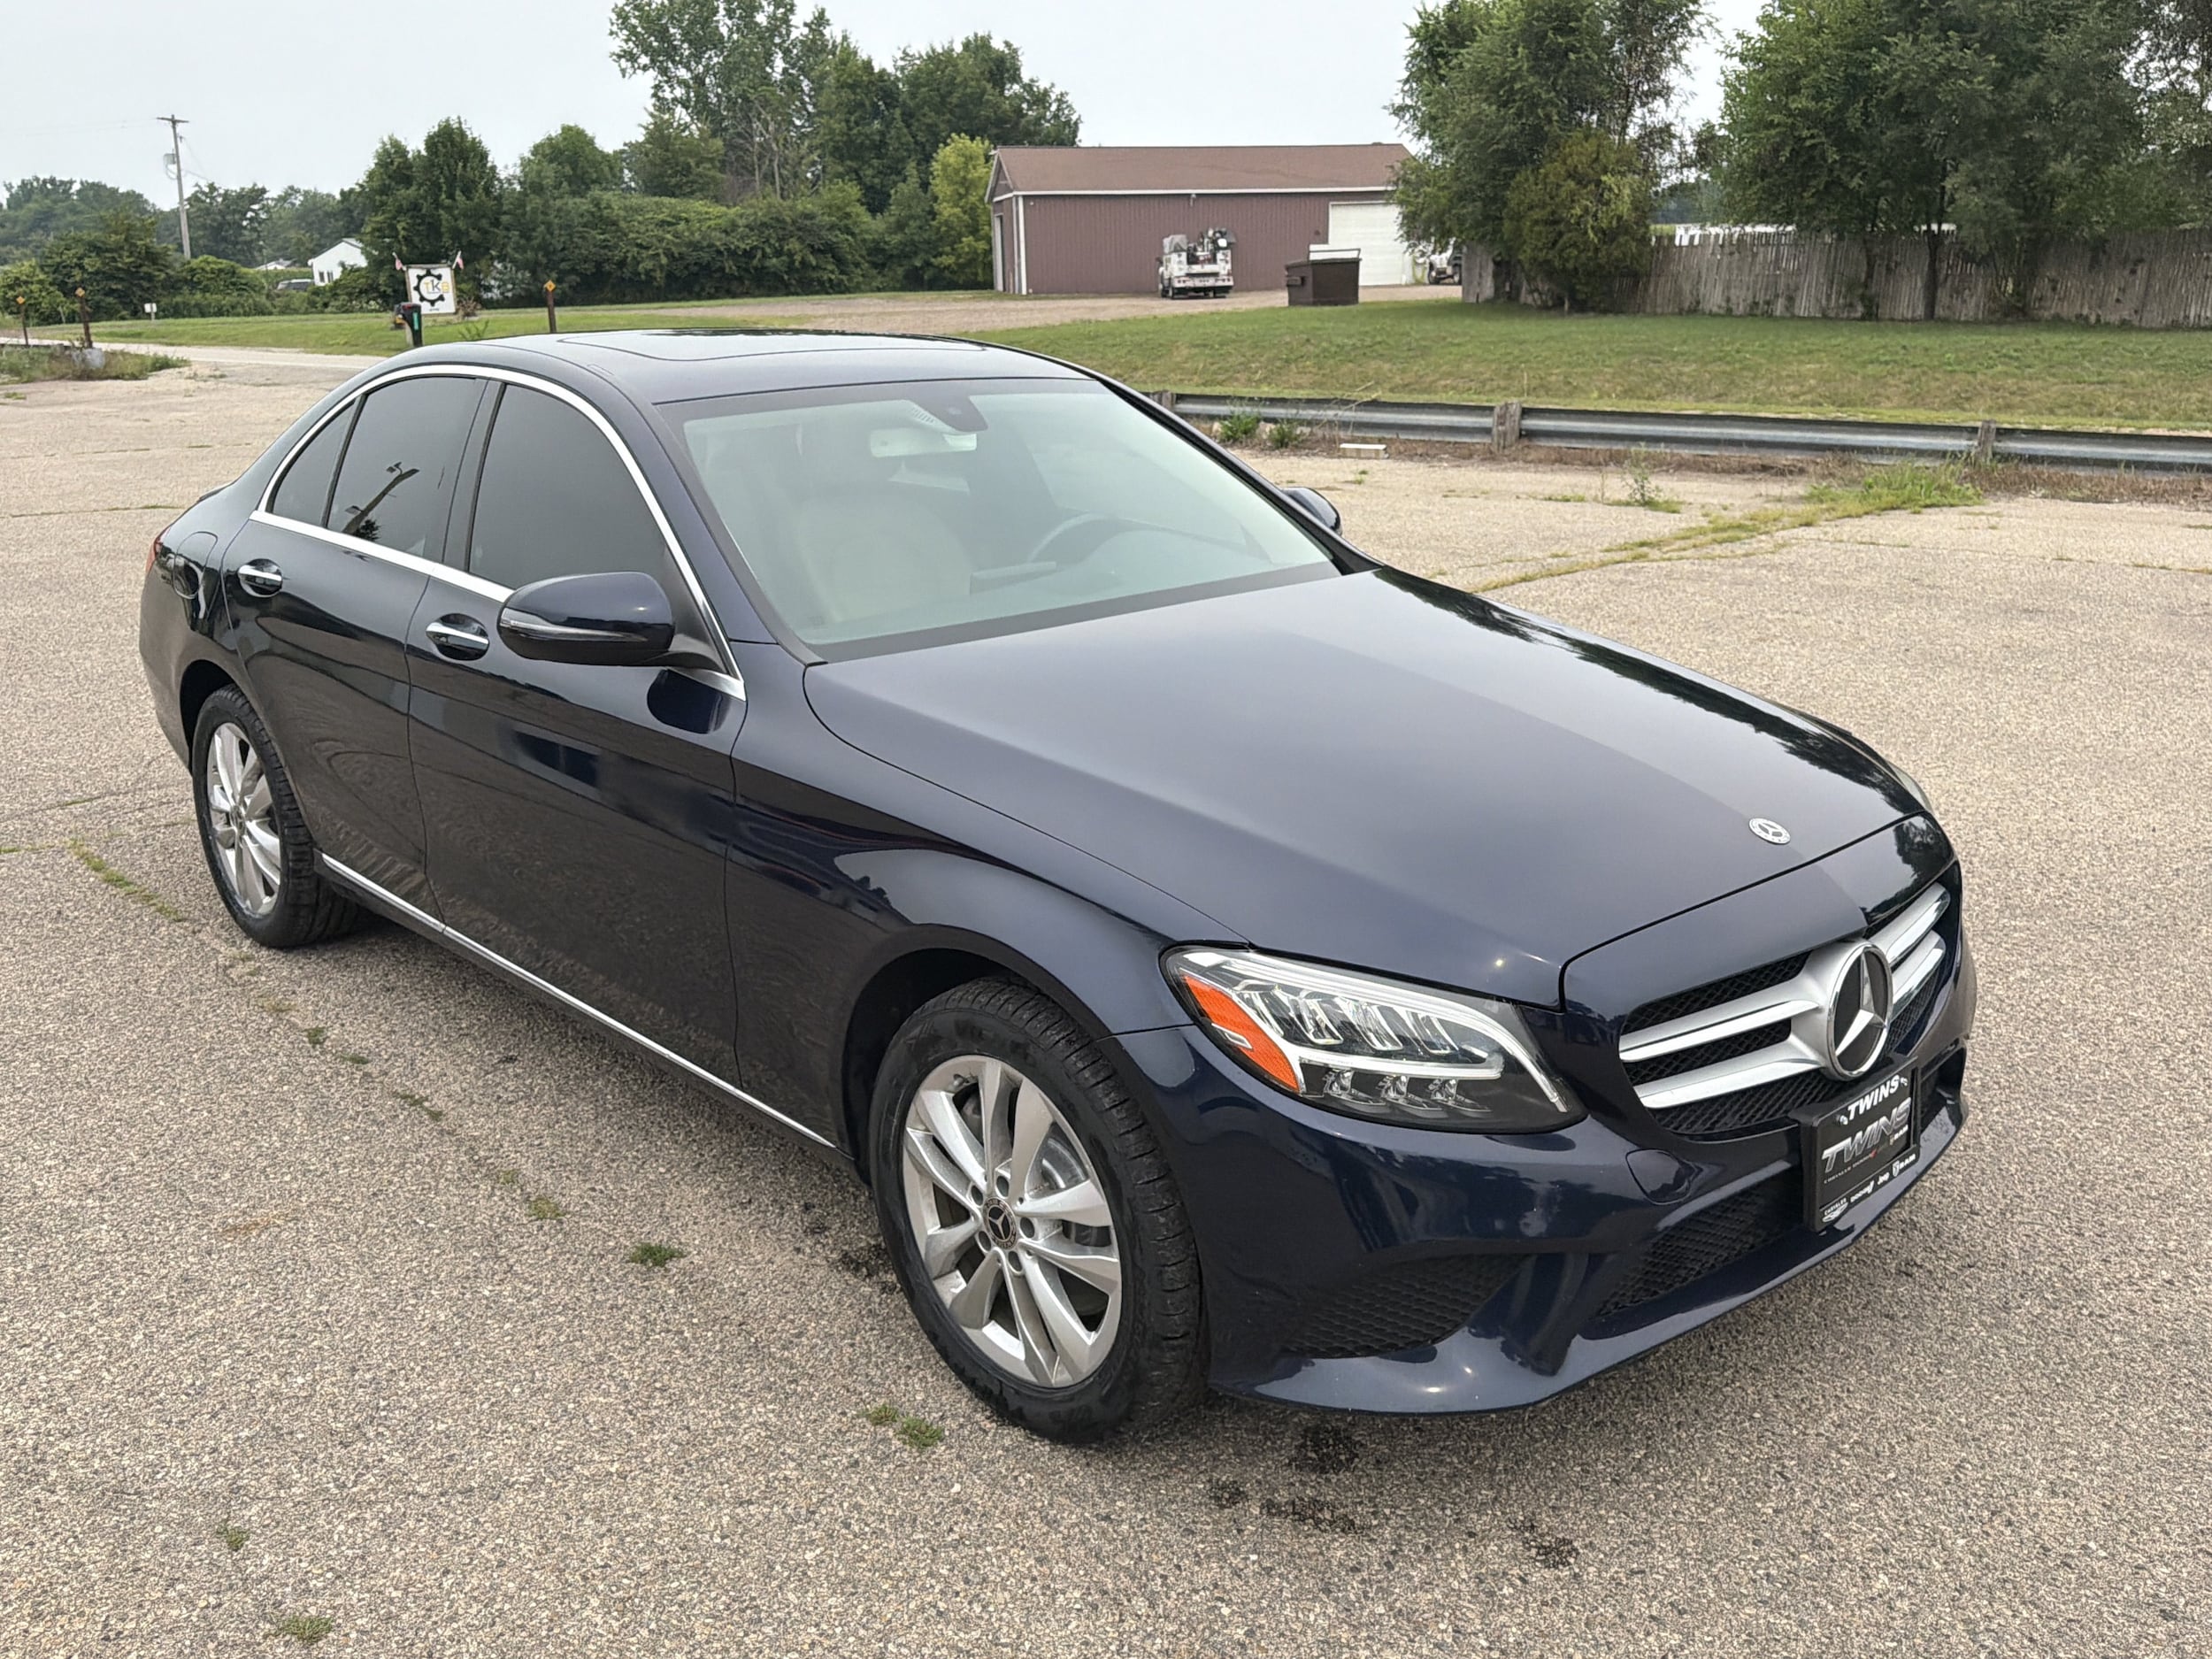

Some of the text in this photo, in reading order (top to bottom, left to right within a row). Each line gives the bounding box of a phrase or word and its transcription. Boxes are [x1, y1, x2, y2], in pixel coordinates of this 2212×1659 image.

[1847, 1074, 1900, 1121] TWINS
[1822, 1097, 1911, 1173] TWINS
[1900, 1154, 1916, 1170] RAM
